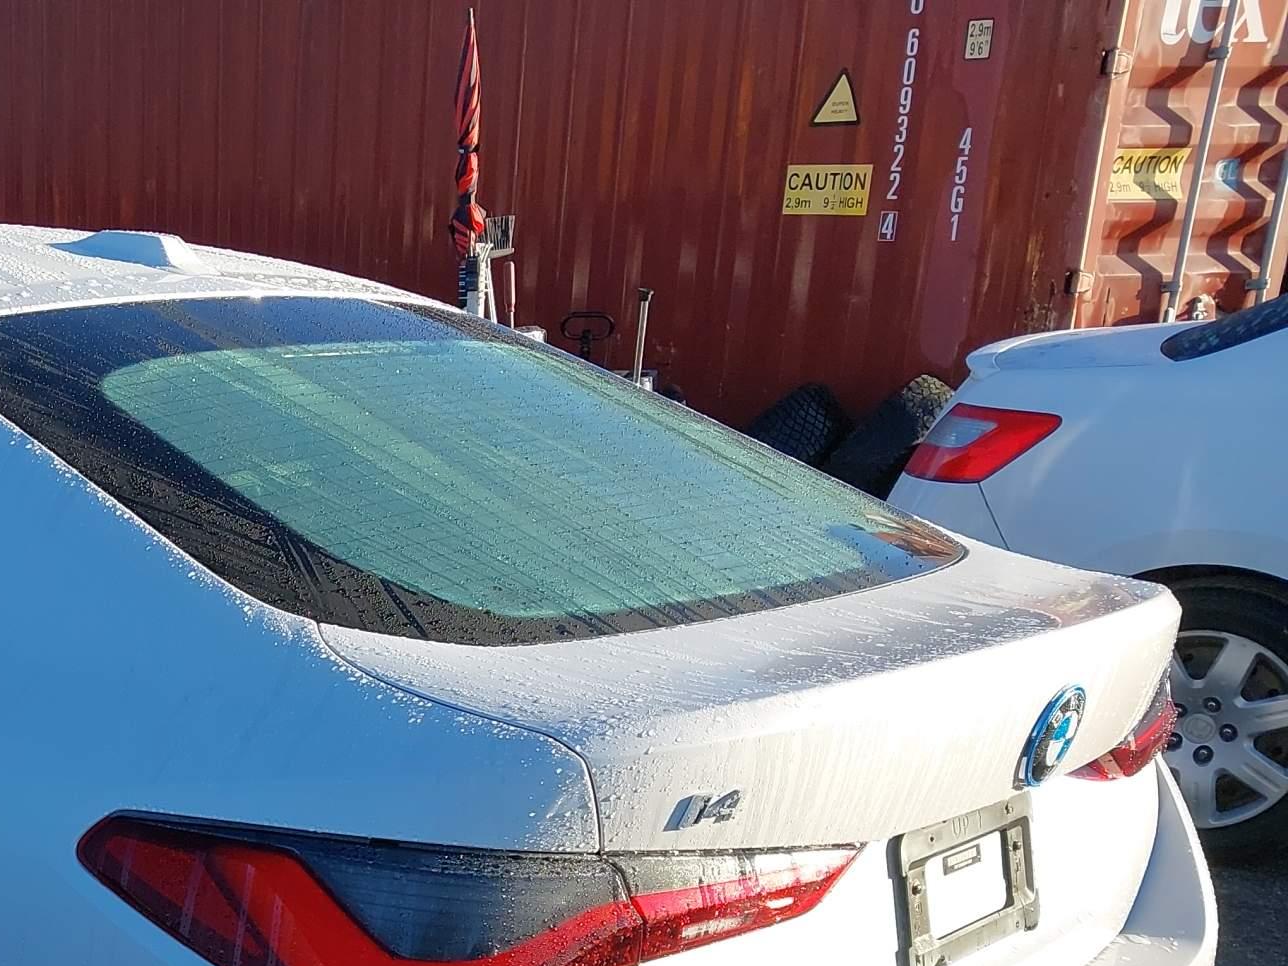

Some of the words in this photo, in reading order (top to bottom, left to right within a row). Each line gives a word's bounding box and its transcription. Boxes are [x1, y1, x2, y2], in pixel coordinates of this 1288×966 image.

[886, 28, 921, 200] 609322
[1112, 155, 1184, 174] CAUTION
[788, 172, 867, 191] CAUTION
[951, 127, 973, 241] 45G1
[838, 197, 864, 209] HIGH
[881, 213, 894, 240] 4
